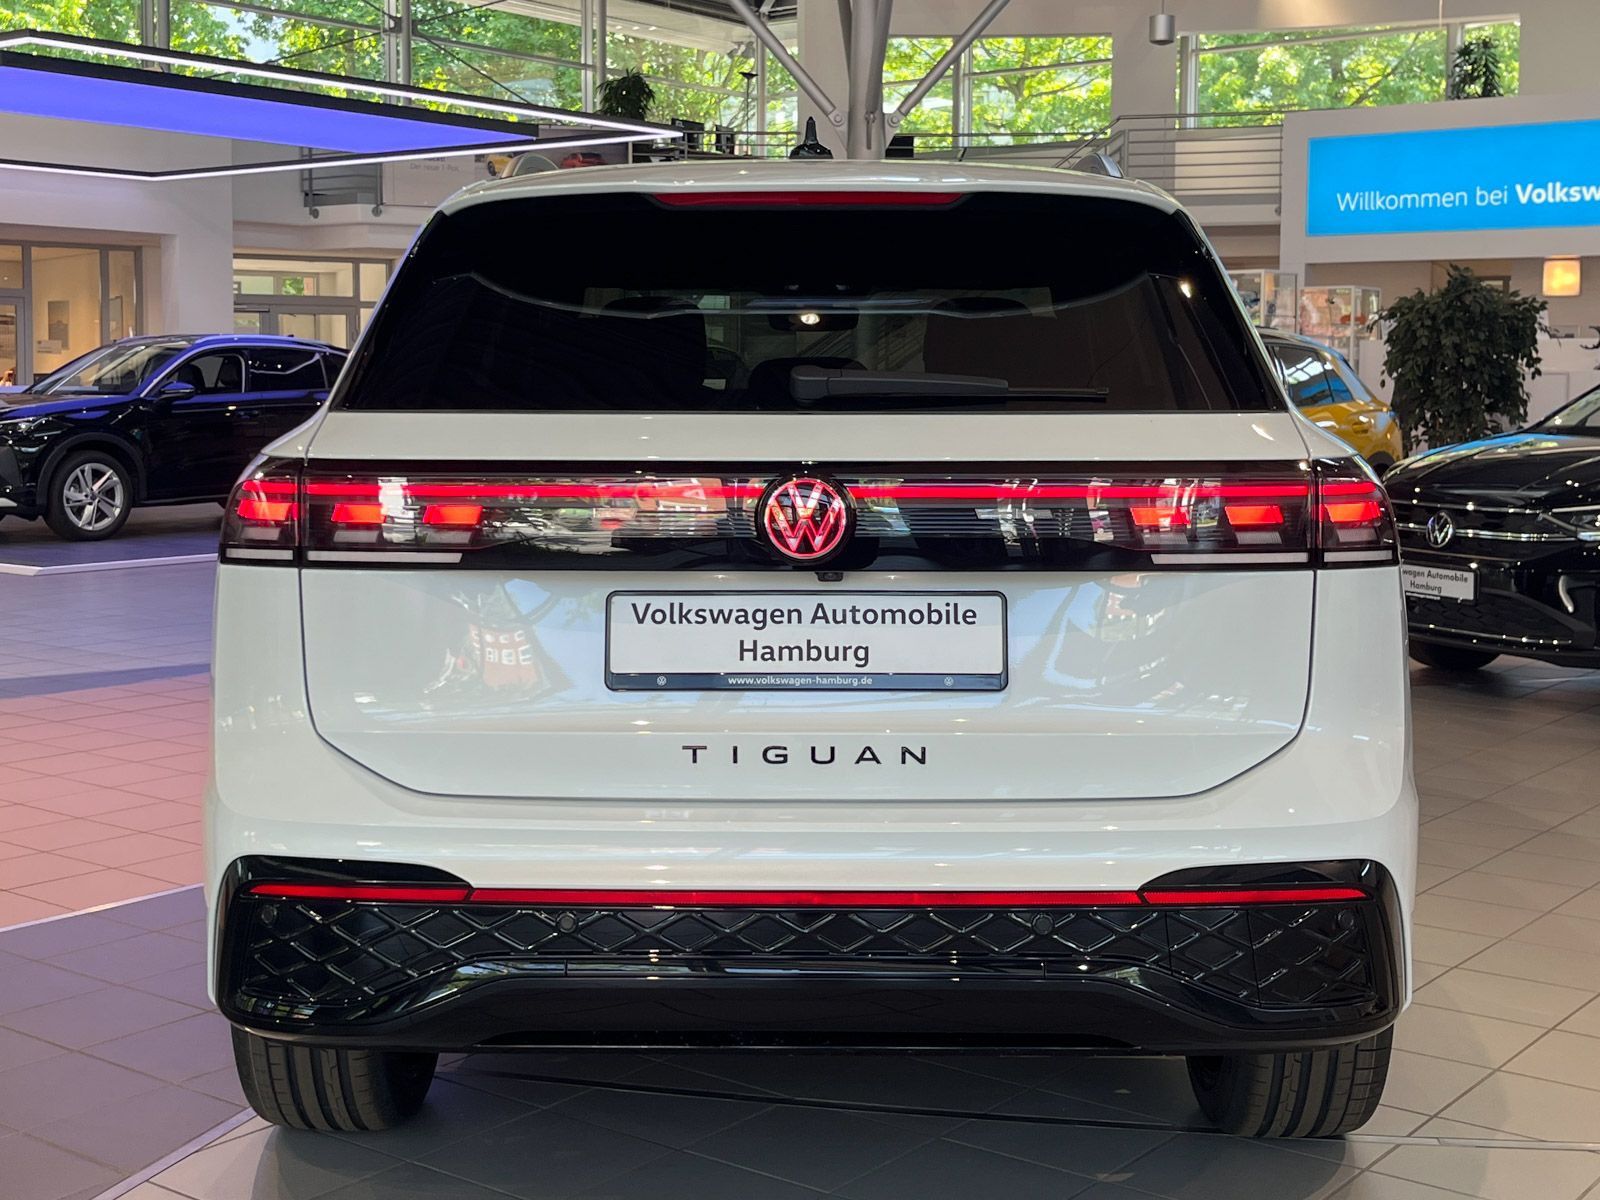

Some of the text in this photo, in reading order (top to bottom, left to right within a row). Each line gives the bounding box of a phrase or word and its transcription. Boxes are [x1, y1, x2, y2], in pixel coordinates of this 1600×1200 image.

[1336, 181, 1600, 212] Willkommen bei Volksw
[1427, 570, 1468, 583] Automobile
[1410, 581, 1442, 594] Hamburg
[631, 603, 978, 631] Volkswagen Automobile
[738, 639, 871, 668] Hamburg
[728, 676, 873, 687] www.volkswagen-hamburg.de
[682, 745, 928, 765] TIGUAN
